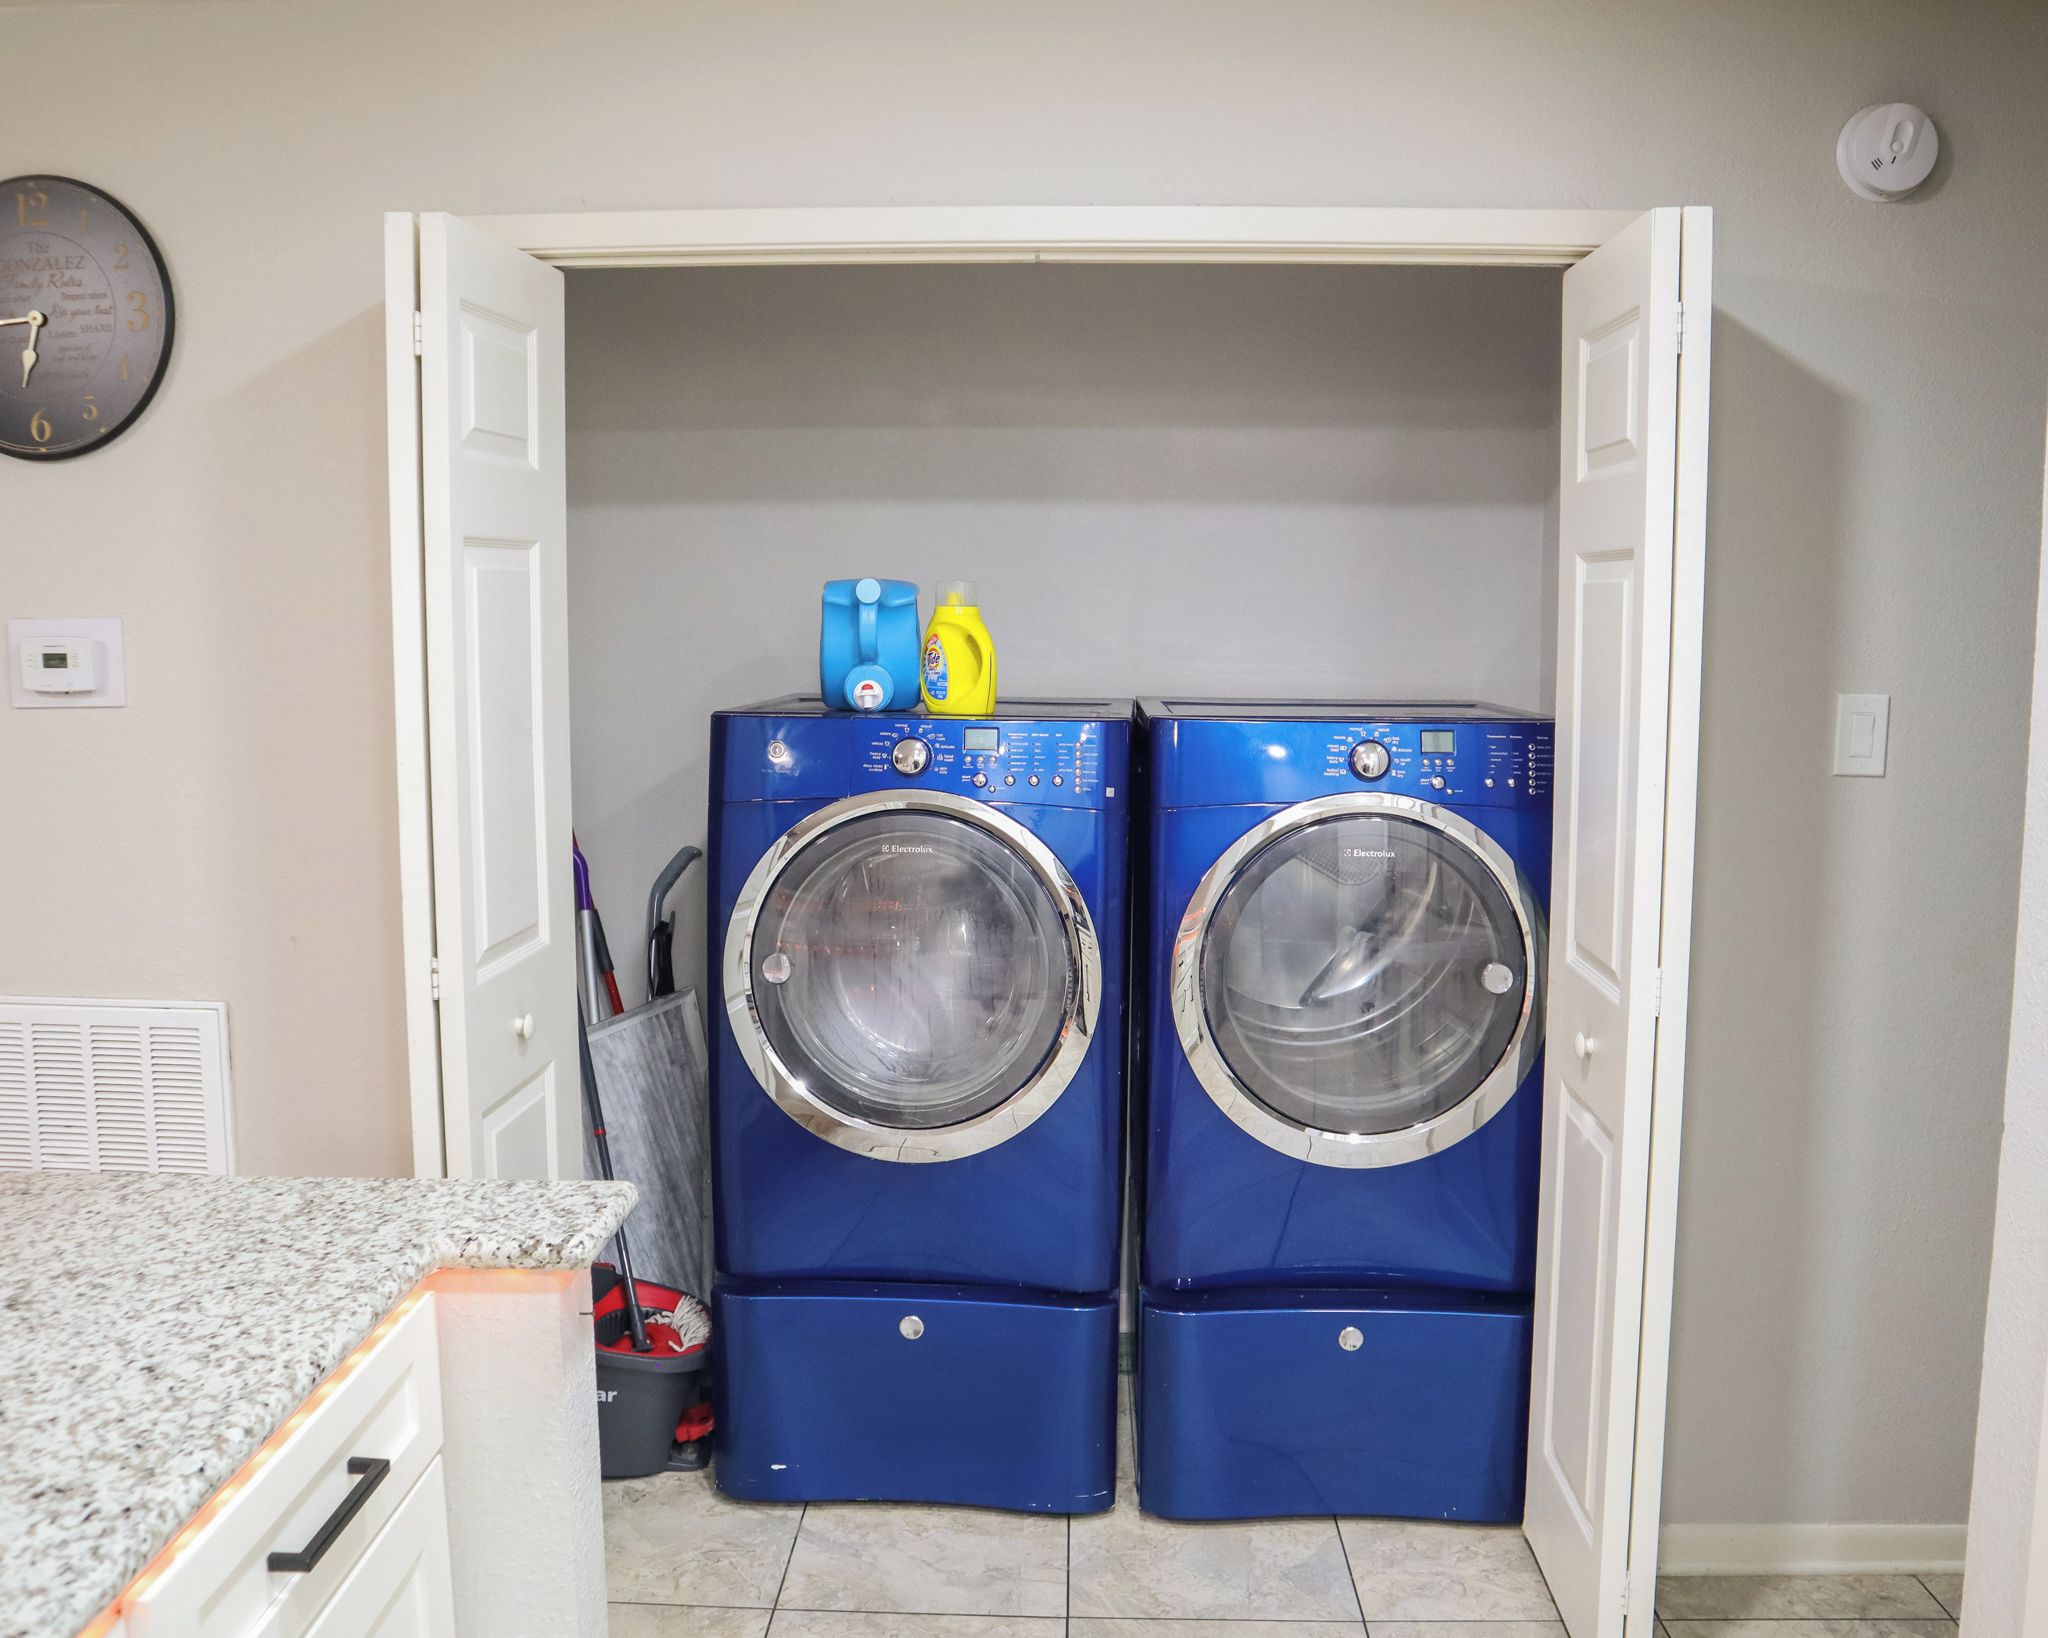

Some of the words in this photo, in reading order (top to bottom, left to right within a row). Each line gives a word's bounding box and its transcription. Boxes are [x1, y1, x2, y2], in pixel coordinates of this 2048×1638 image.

[16, 191, 49, 226] 12
[113, 243, 129, 271] 2
[128, 290, 150, 333] 3
[30, 407, 52, 442] 6
[927, 651, 941, 664] Tide
[891, 845, 933, 853] Electrolux
[1353, 849, 1396, 858] Electrolux
